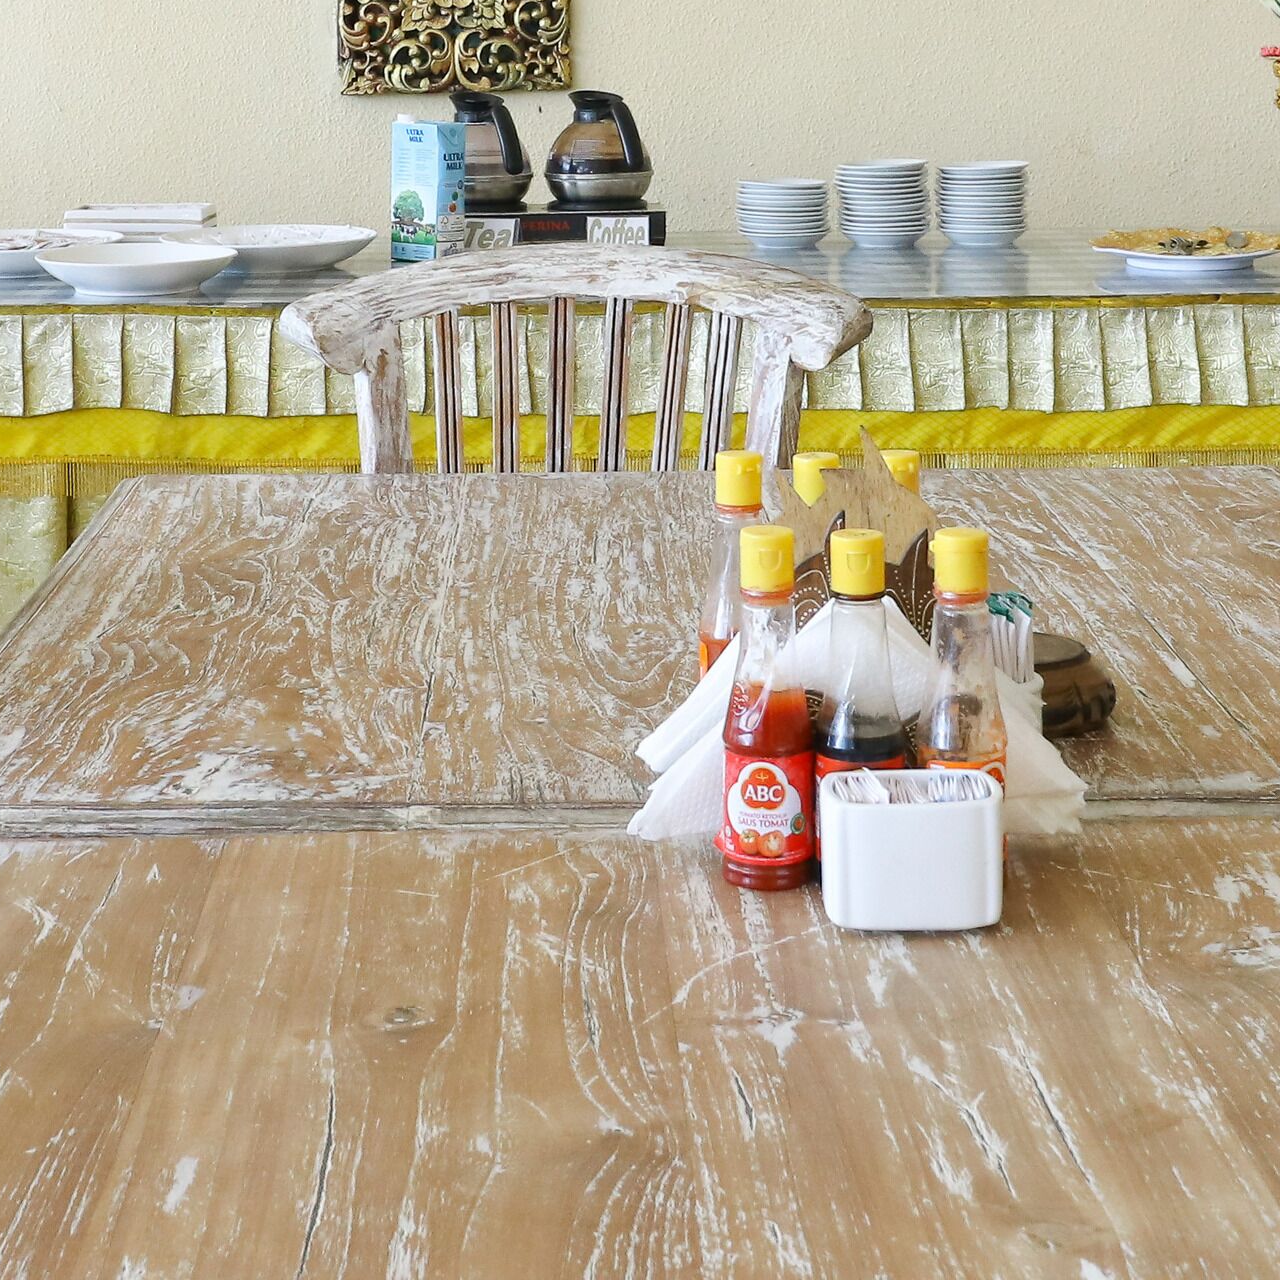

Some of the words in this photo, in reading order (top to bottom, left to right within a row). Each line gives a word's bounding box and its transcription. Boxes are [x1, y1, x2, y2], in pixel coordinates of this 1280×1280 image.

[406, 128, 424, 136] ULTRA
[443, 152, 464, 162] ULTRA
[446, 162, 463, 171] MILK
[464, 221, 511, 248] Tea
[589, 218, 645, 245] Coffee
[744, 784, 782, 802] ABC
[738, 817, 757, 827] SAUS
[760, 818, 789, 828] TOMAT
